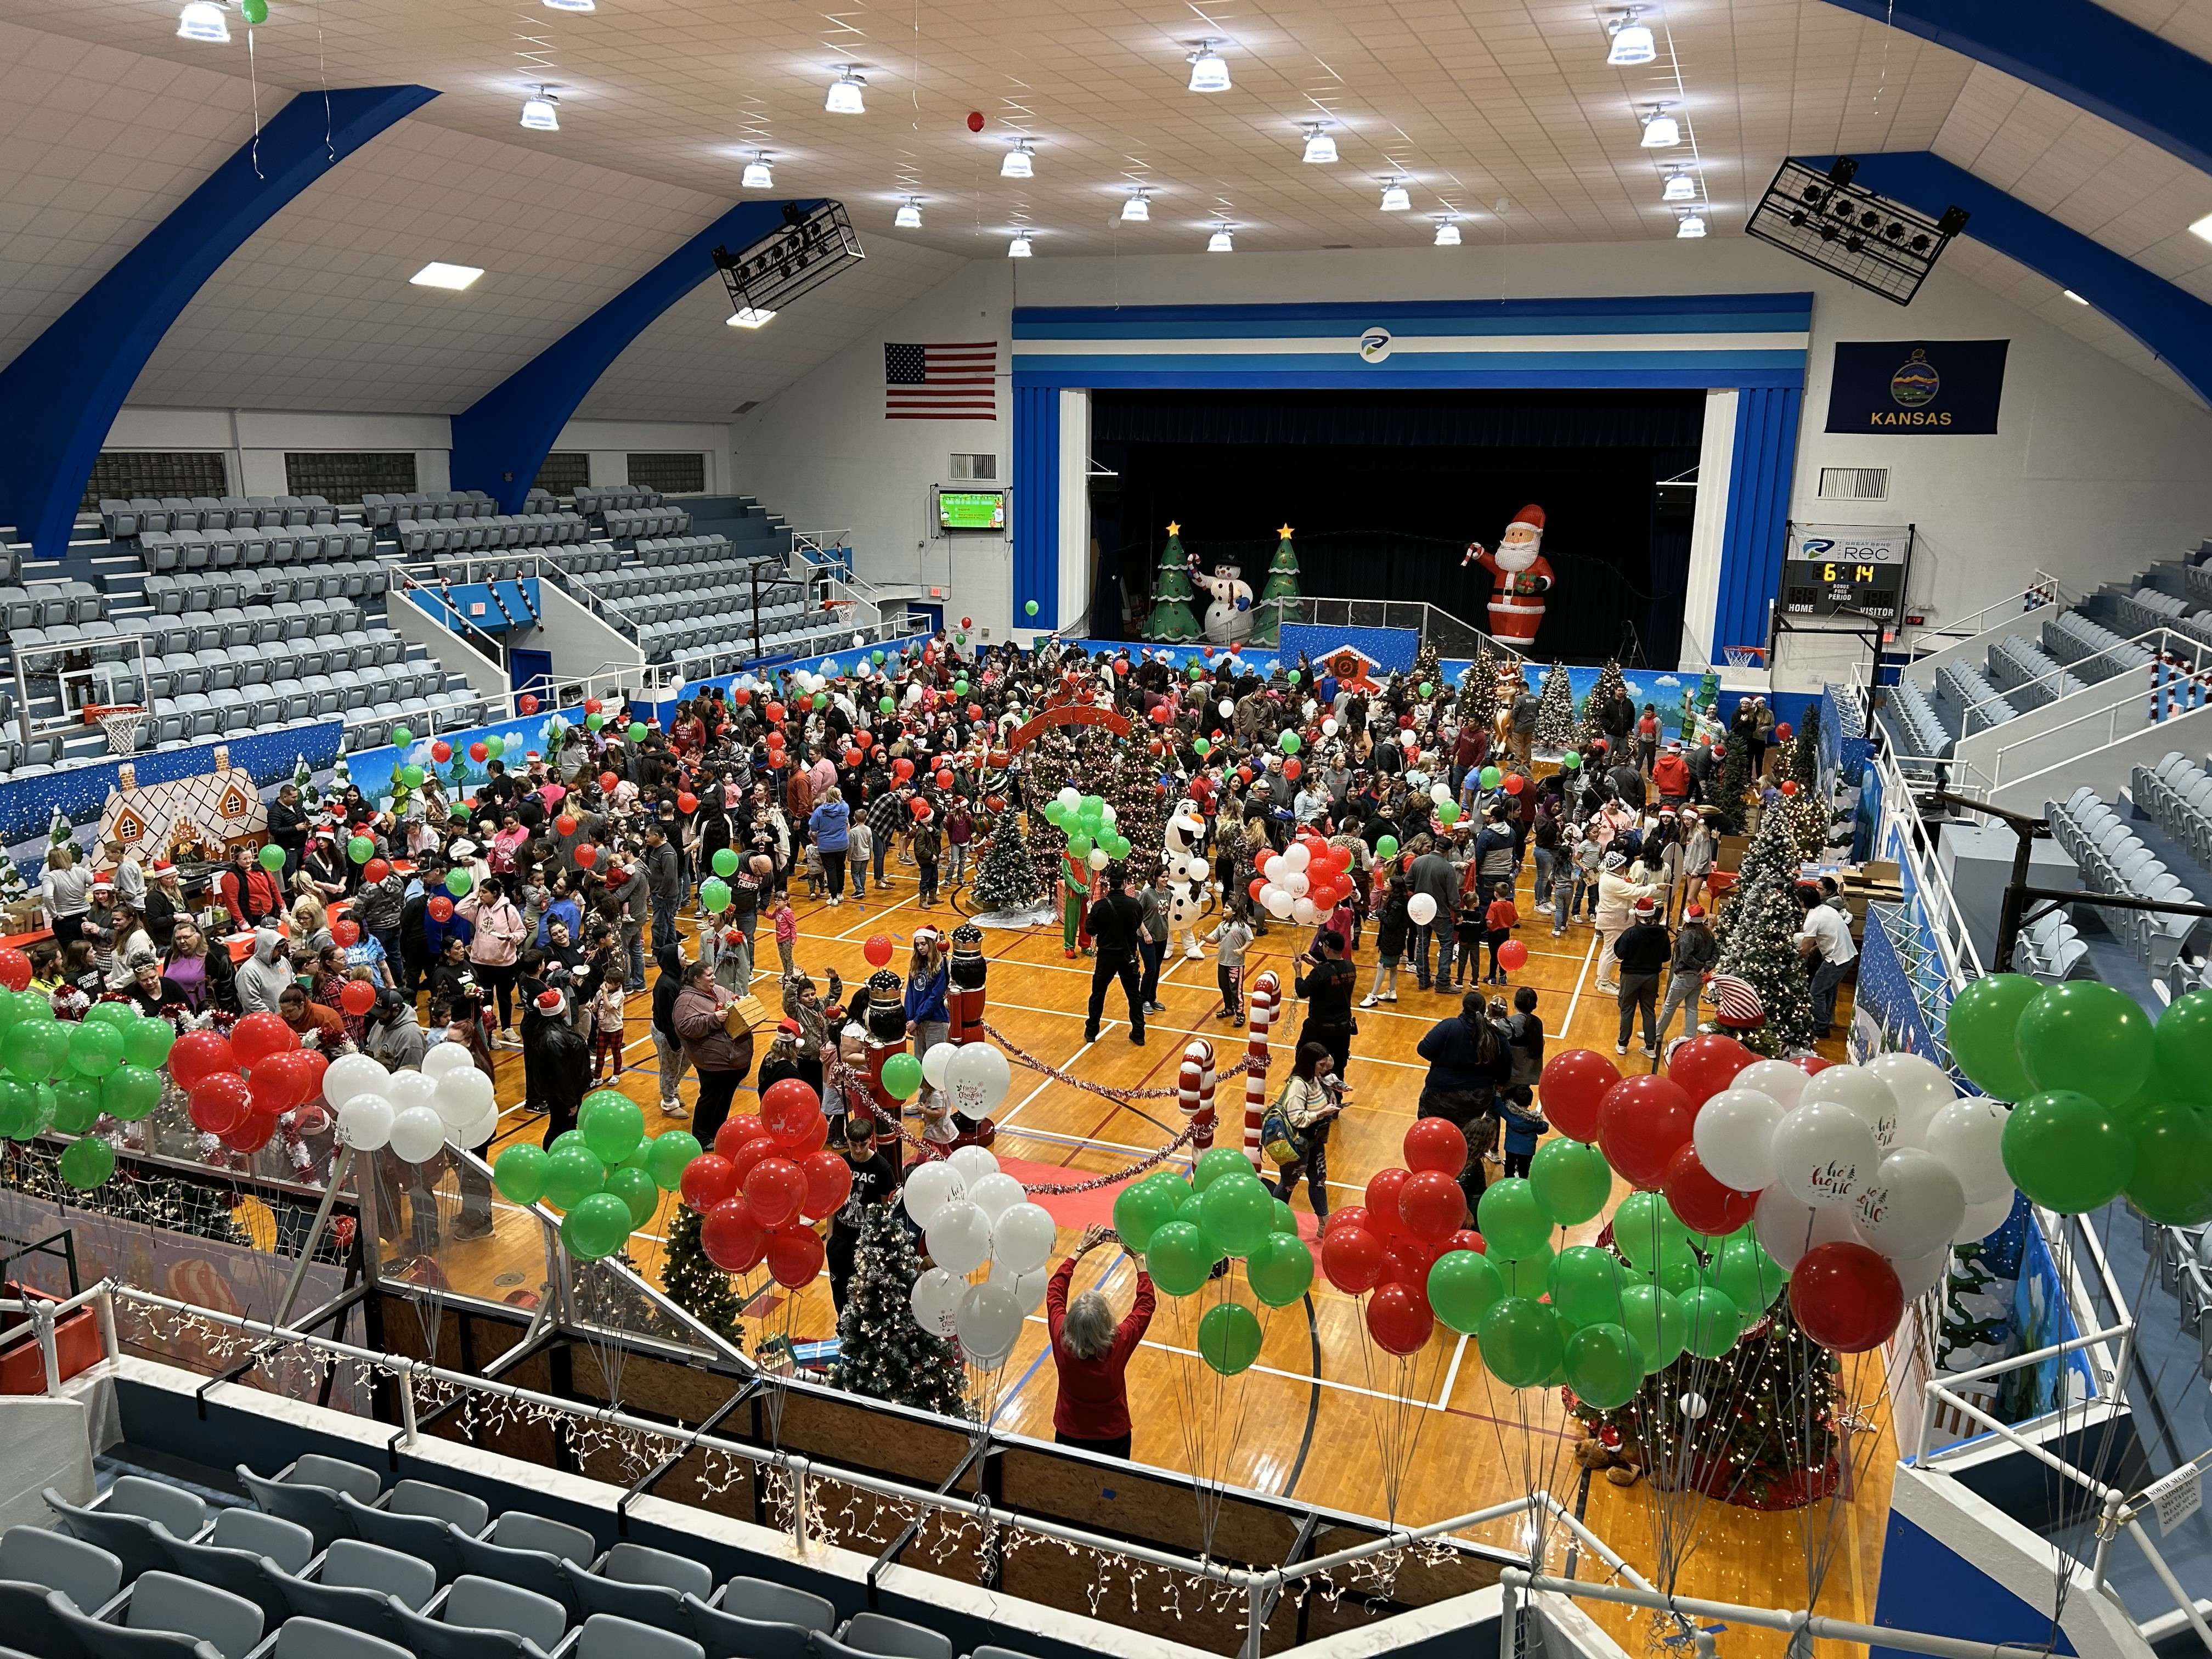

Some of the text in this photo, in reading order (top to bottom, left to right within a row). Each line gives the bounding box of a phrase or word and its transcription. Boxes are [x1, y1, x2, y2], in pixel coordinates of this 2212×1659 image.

[1871, 413, 1952, 425] KANSAS
[1788, 604, 1814, 613] HOME
[1860, 607, 1894, 617] VISITOR
[851, 1169, 876, 1183] PAC
[2148, 1466, 2197, 1498] NORTH SECTION
